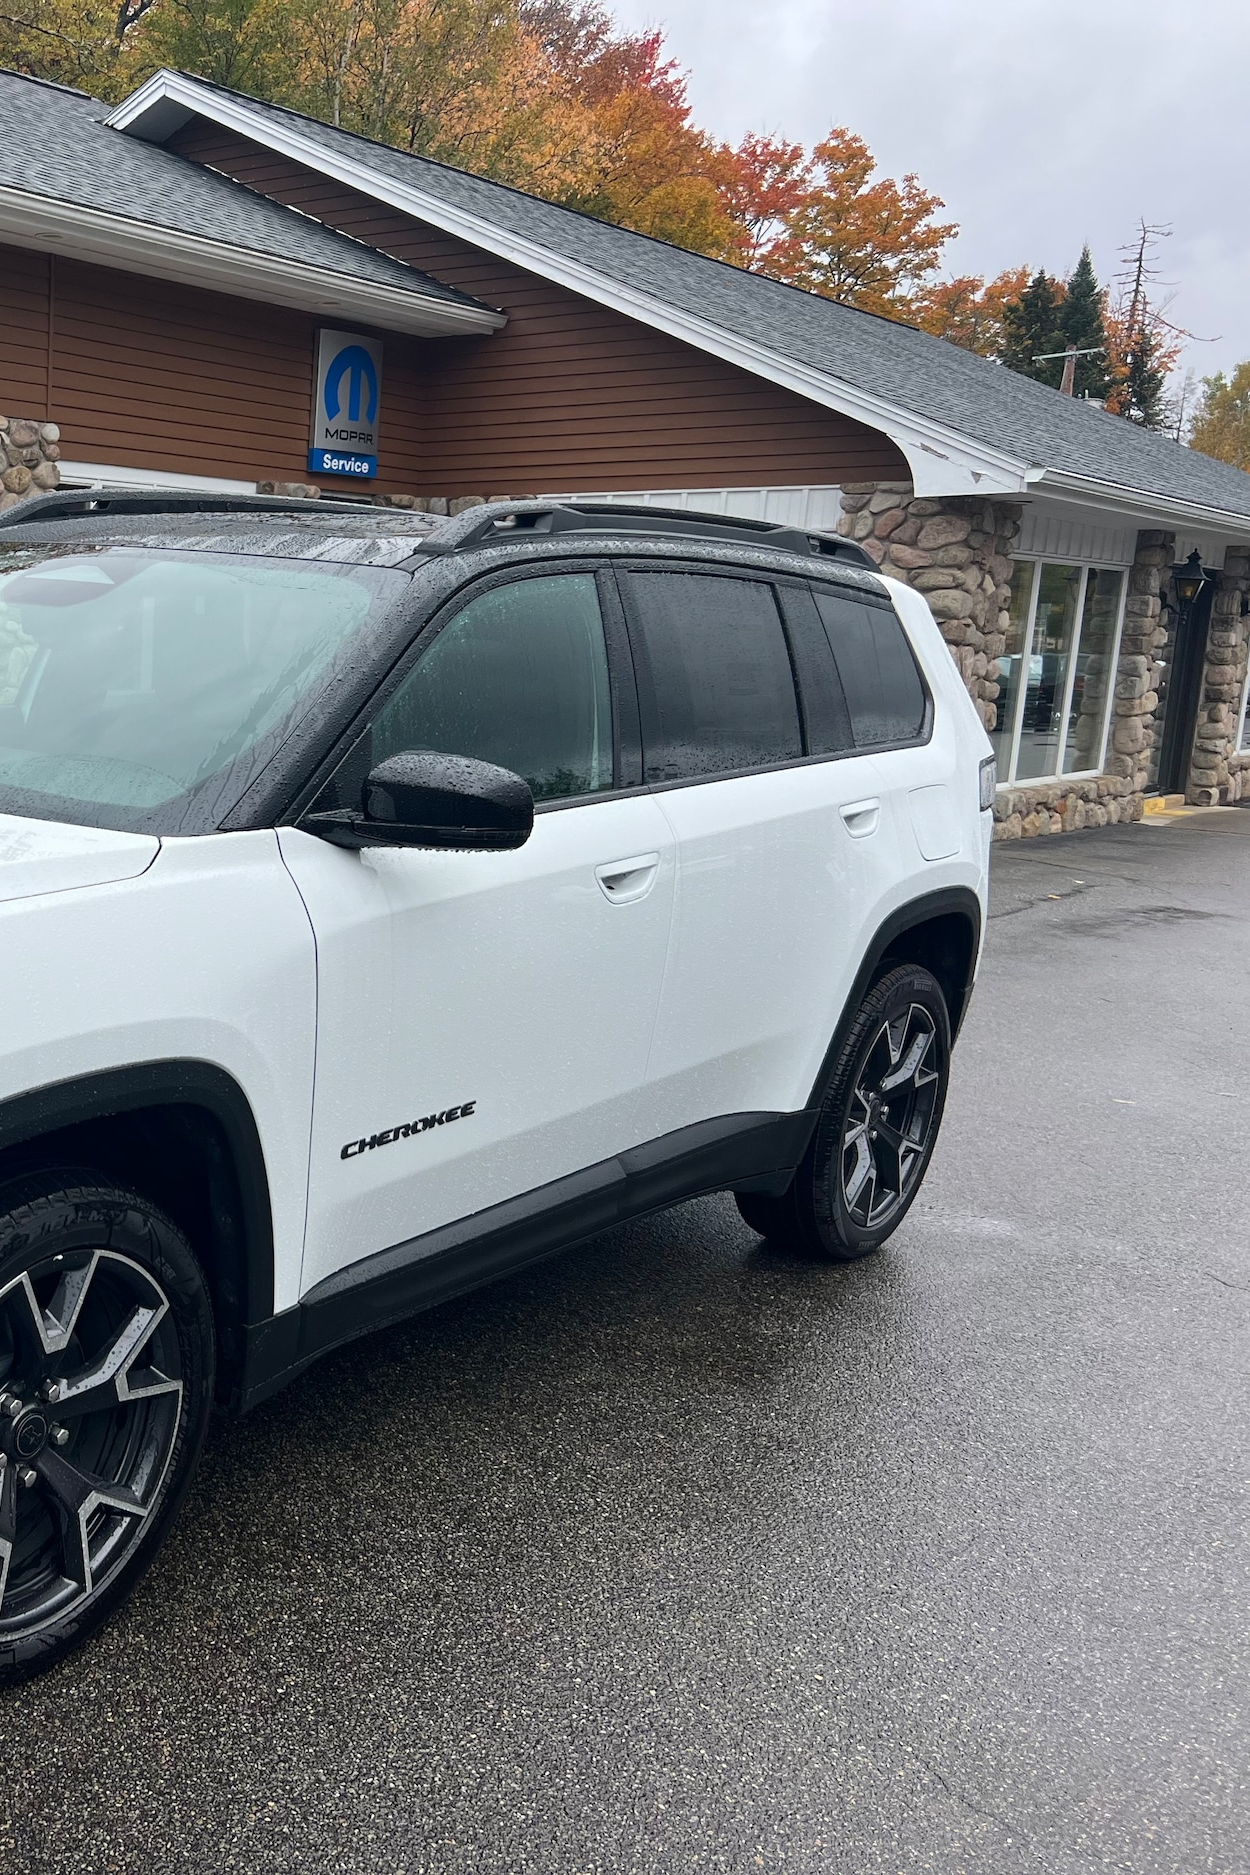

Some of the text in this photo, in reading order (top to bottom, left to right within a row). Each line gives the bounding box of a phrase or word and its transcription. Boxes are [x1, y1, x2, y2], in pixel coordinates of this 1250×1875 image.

[325, 427, 374, 445] MOPAR
[322, 453, 370, 474] Service
[340, 1100, 477, 1160] CHEROKEE
